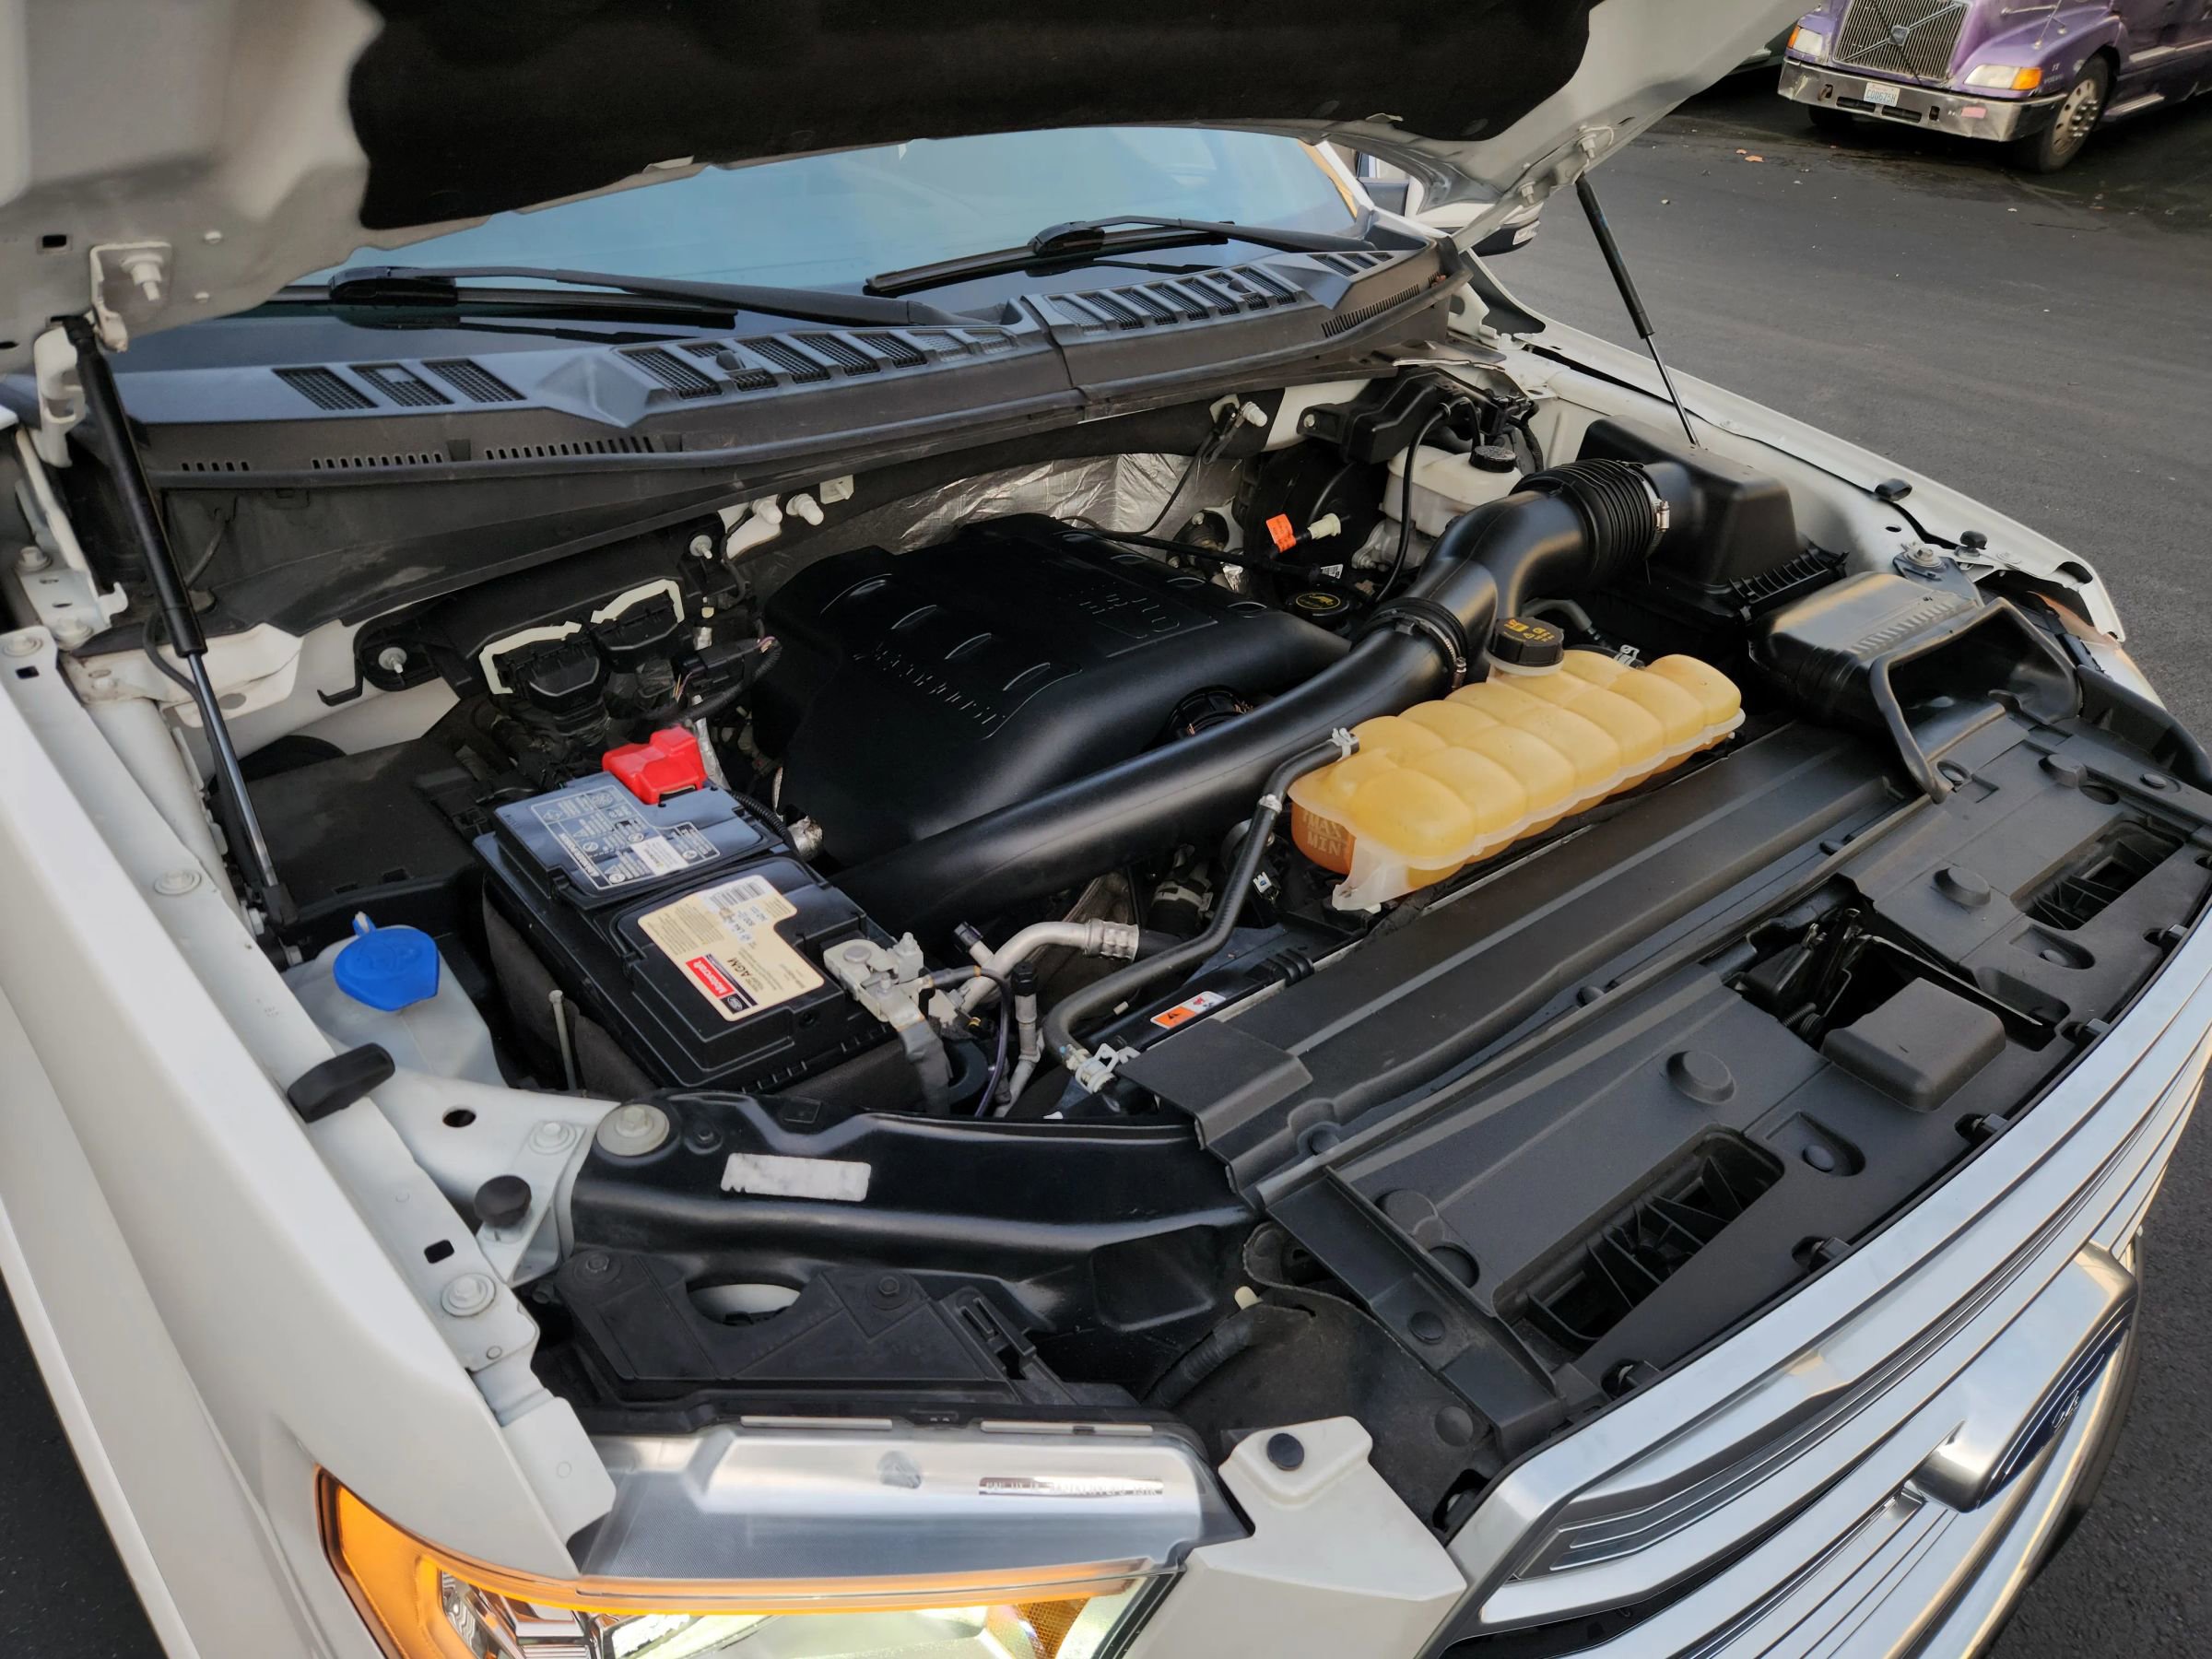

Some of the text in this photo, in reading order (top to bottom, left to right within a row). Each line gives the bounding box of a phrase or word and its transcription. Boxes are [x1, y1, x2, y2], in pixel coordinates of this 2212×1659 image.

[1307, 830, 1342, 856] MIN
[693, 960, 728, 994] Motorcraft
[726, 958, 751, 977] AGM
